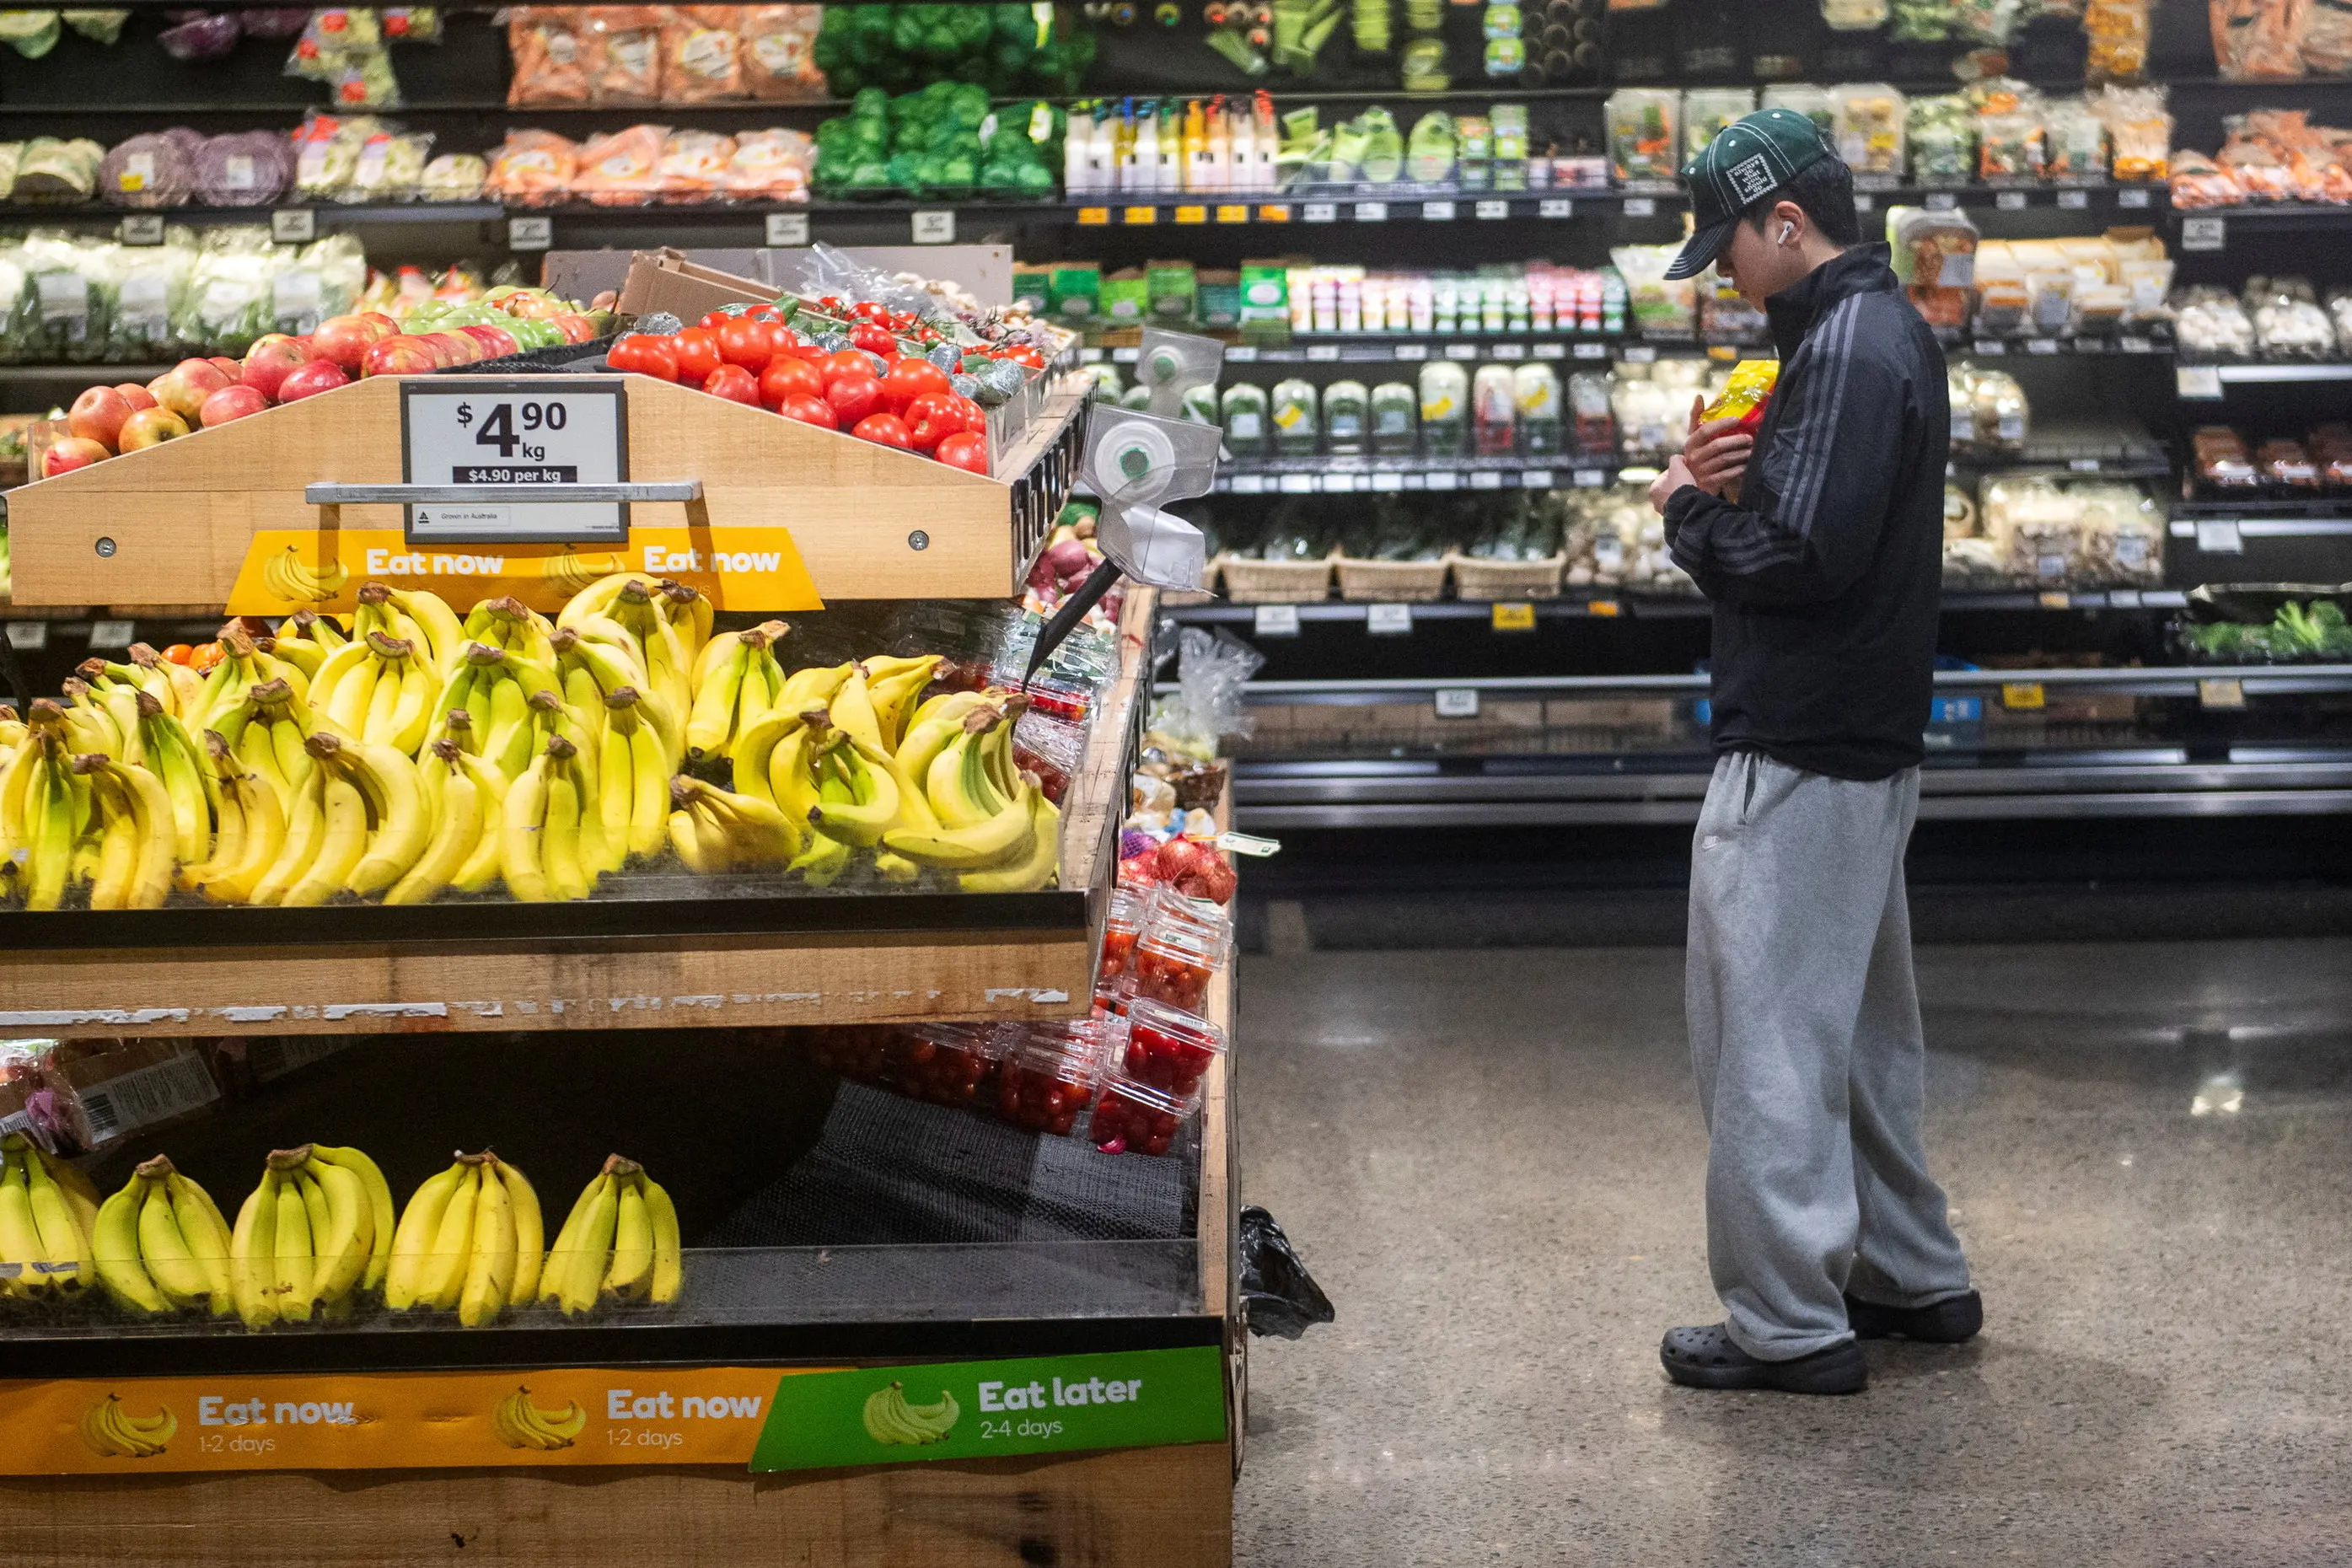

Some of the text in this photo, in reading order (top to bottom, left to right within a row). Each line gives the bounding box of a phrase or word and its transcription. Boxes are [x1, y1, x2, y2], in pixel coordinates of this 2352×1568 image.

[1742, 169, 1760, 183] what
[1744, 176, 1768, 192] should
[522, 442, 545, 461] kg
[469, 469, 561, 483] $4.90 per kg
[366, 548, 504, 575] Eat now
[644, 545, 781, 573] Eat now
[608, 1389, 762, 1419] Eat now
[978, 1377, 1141, 1412] Eat later
[198, 1396, 355, 1426] Eat now
[607, 1428, 683, 1449] 1-2 days
[980, 1418, 1064, 1439] 2-4 days
[199, 1434, 276, 1456] 1-2 days
